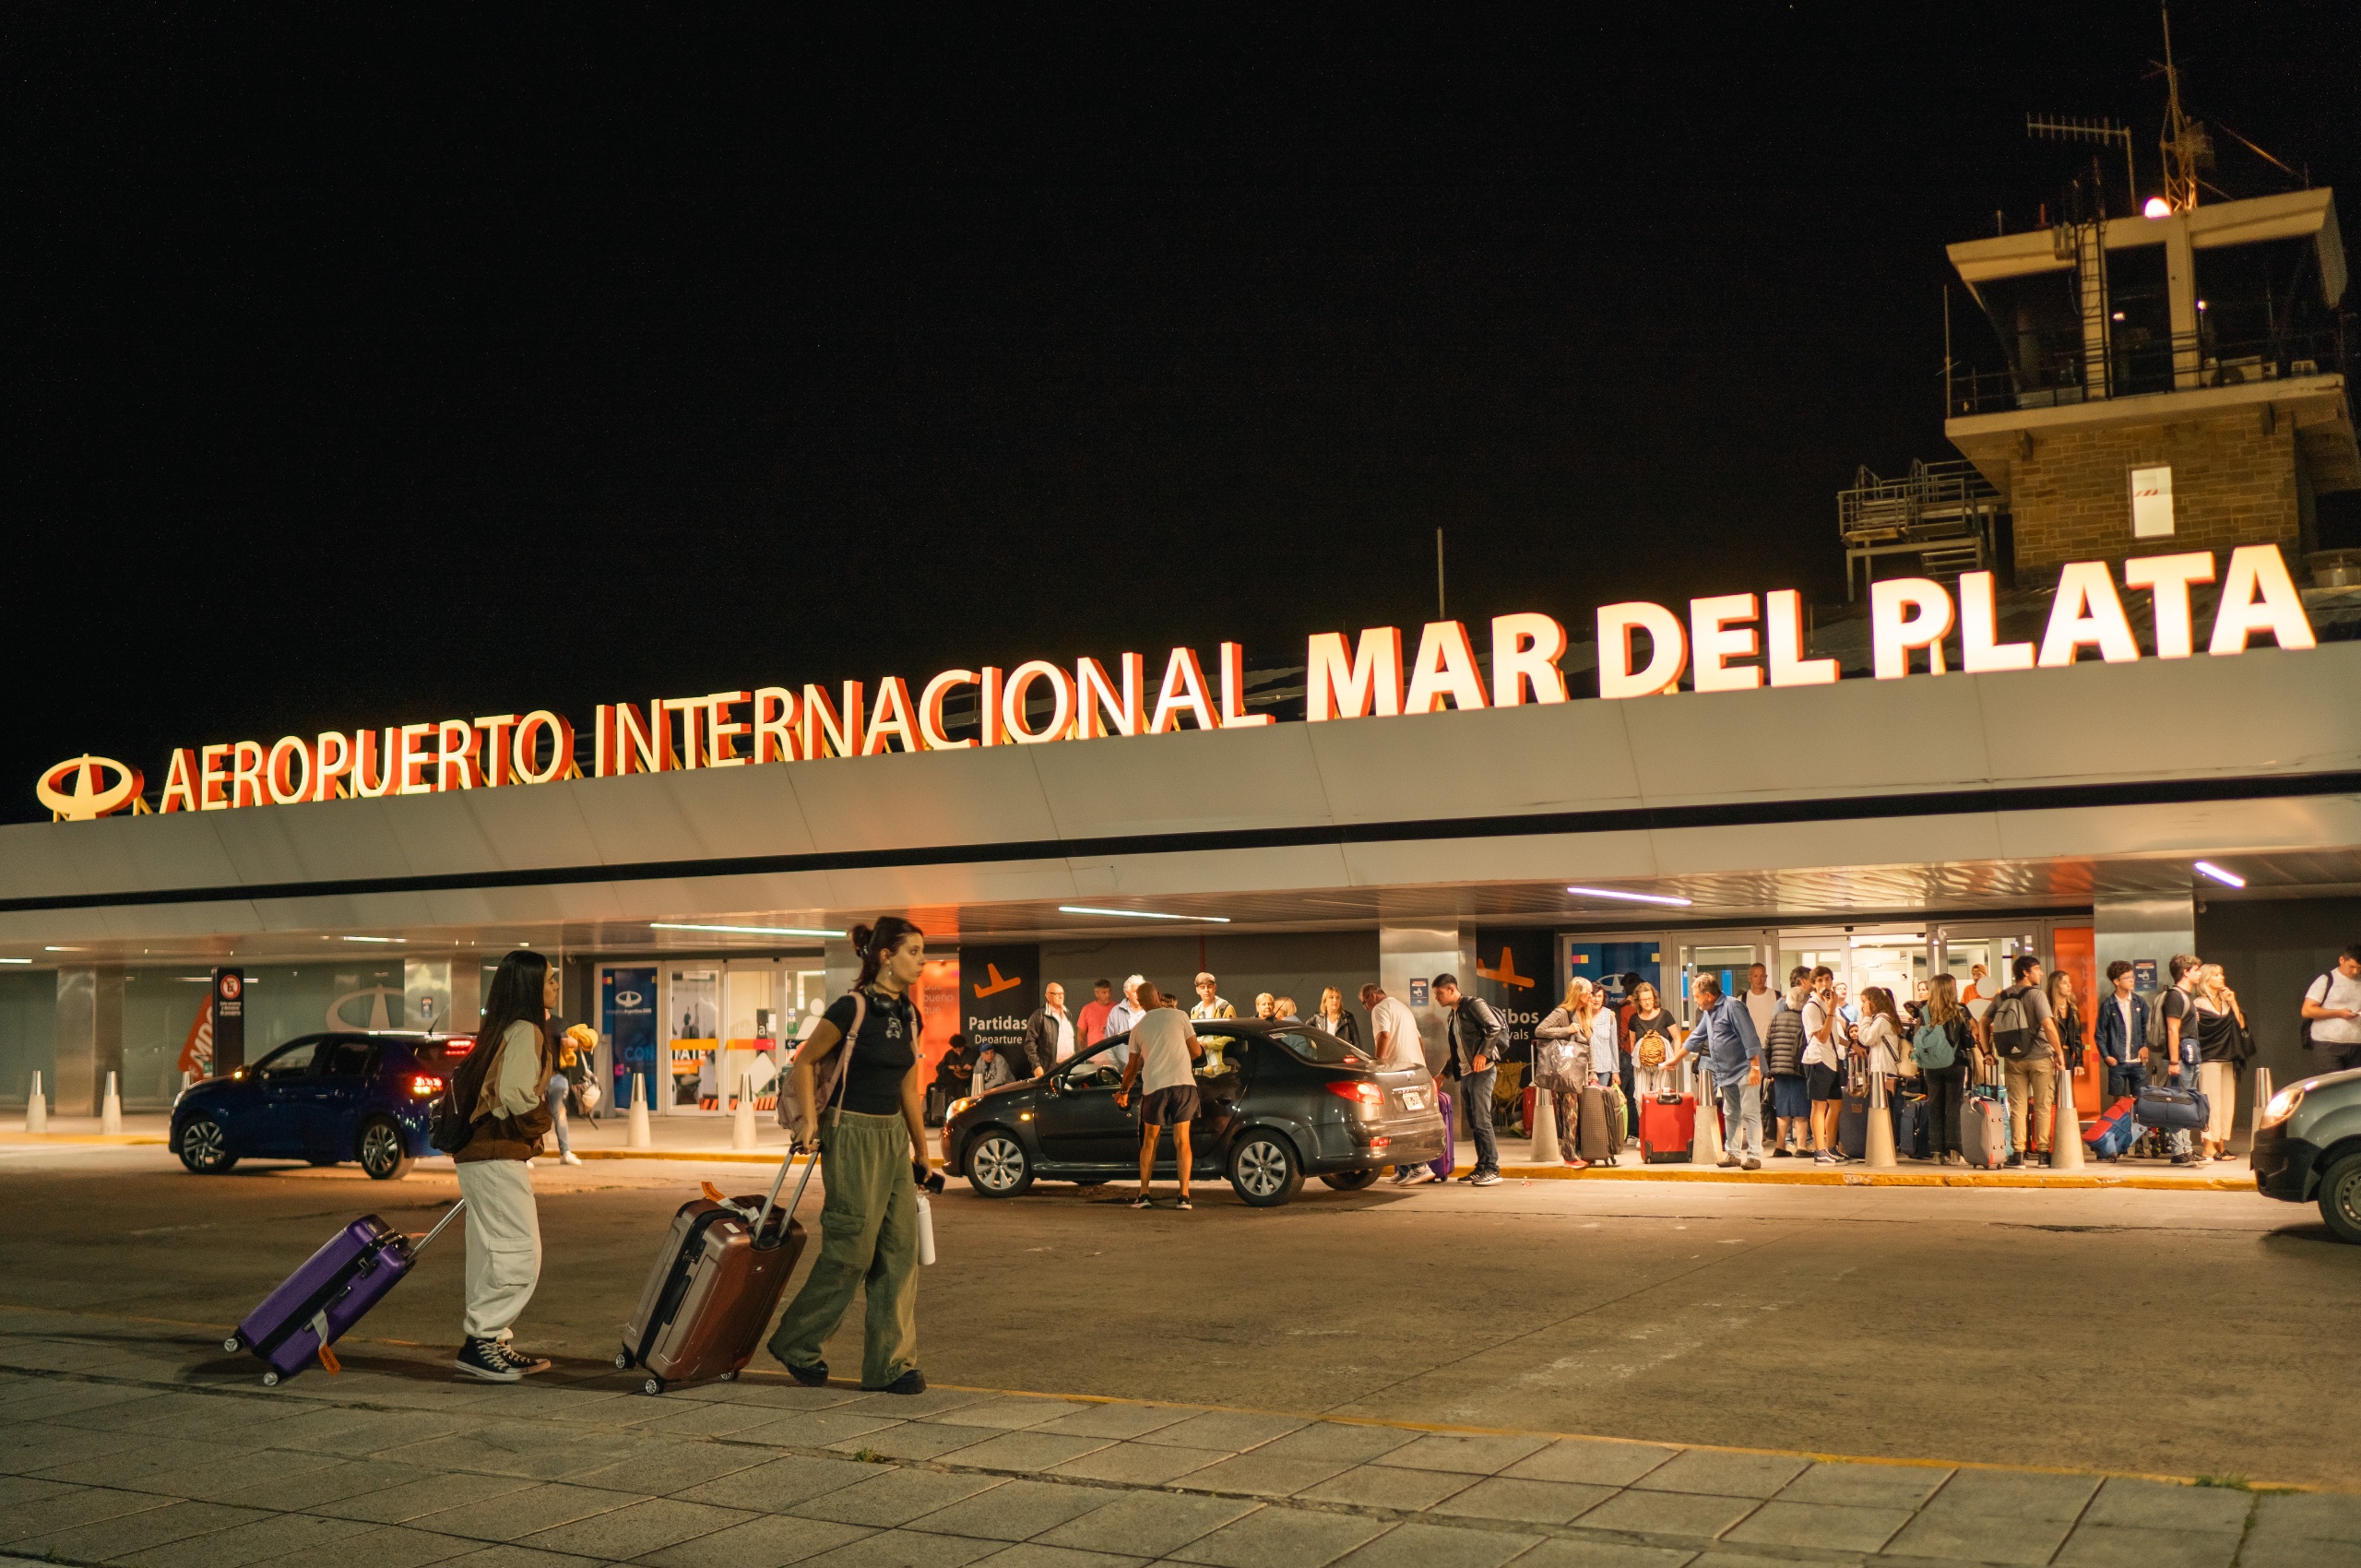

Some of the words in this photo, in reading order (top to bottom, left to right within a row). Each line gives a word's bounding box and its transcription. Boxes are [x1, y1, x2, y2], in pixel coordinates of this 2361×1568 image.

[160, 710, 568, 814] AEROPUERTO
[596, 642, 1275, 778] INTERNACIONAL
[1306, 612, 1567, 721] MAR
[1596, 589, 1840, 700] DEL
[1870, 544, 2317, 679] PLATA
[923, 992, 954, 1003] bueno
[968, 1016, 1028, 1030] Partidas
[1502, 1008, 1539, 1025] ibos
[975, 1034, 1023, 1044] Departure
